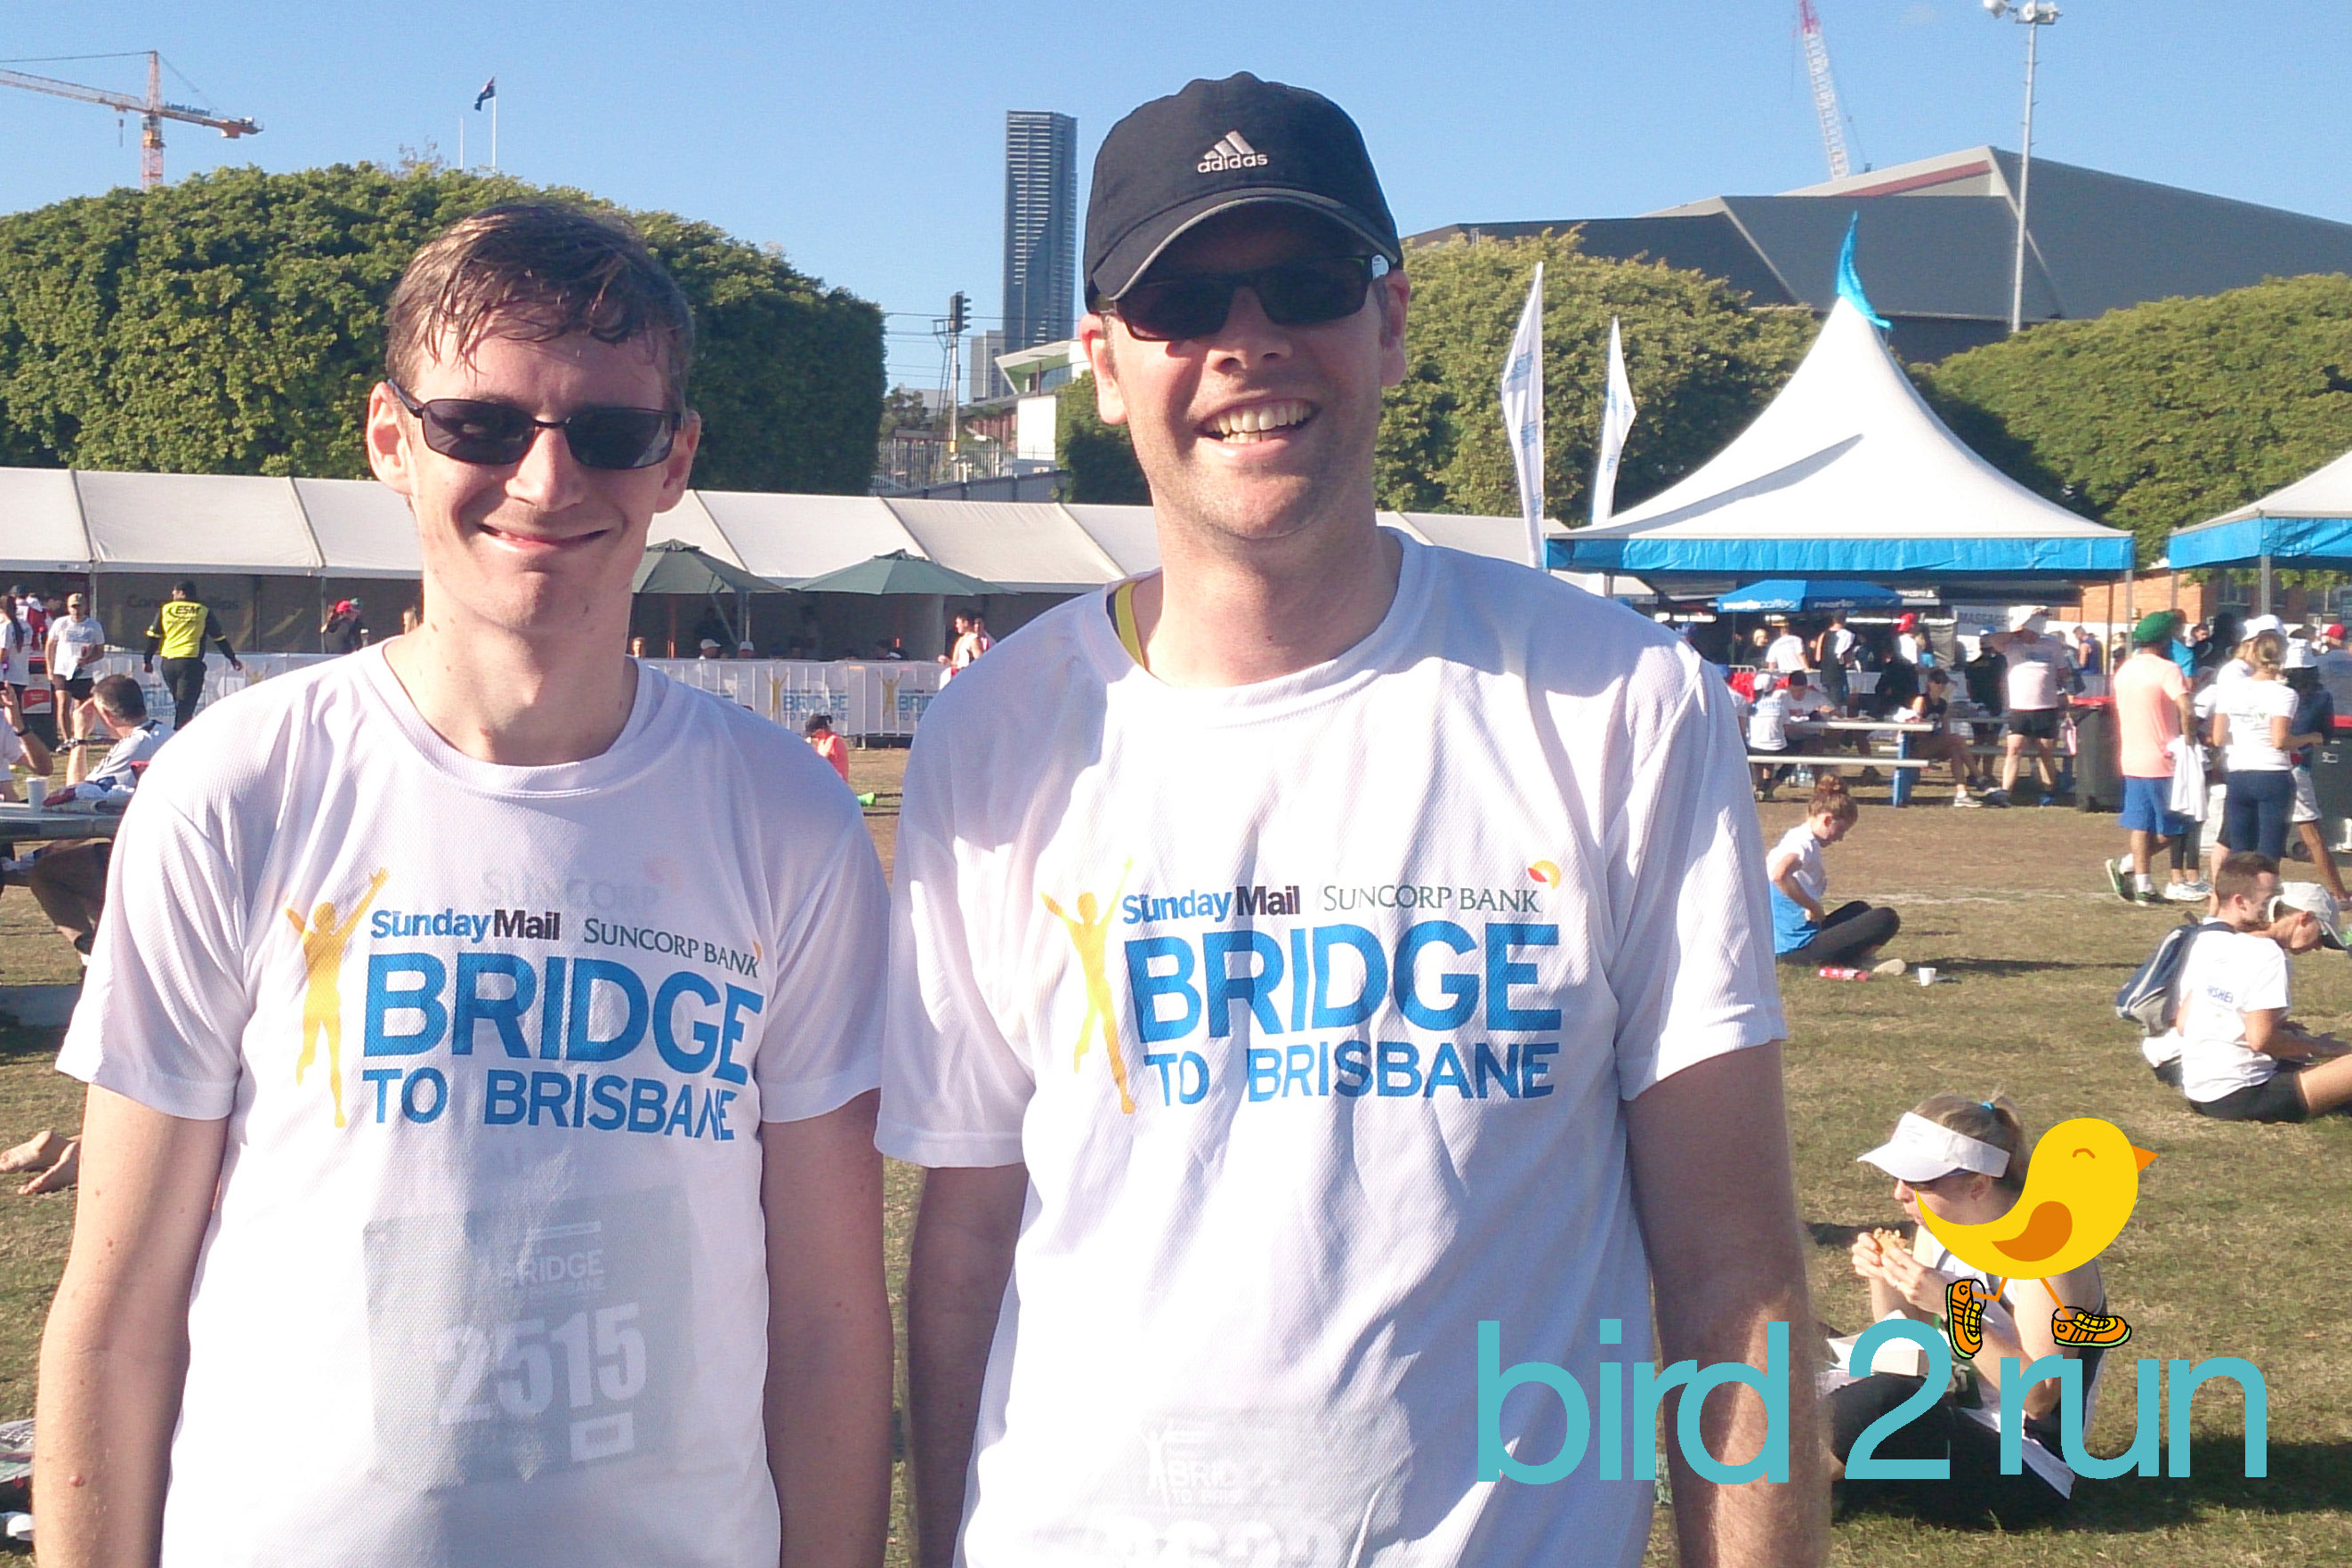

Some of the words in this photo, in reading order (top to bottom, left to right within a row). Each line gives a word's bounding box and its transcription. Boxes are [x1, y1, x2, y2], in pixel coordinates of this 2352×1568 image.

[1197, 153, 1269, 174] adidas
[1323, 885, 1452, 912] SUNCORP
[1459, 887, 1540, 913] BANK
[584, 917, 699, 959] SUNCORP
[704, 942, 760, 979] BANK
[1123, 919, 1563, 1044] BRIDGE
[362, 952, 764, 1086] BRIDGE
[361, 1067, 448, 1124] TO
[483, 1069, 738, 1142] BRISBANE
[1144, 1051, 1211, 1107] TO
[1247, 1040, 1560, 1103] BRISBANE
[504, 1248, 606, 1289] RIDGE
[437, 1302, 648, 1425] 2515
